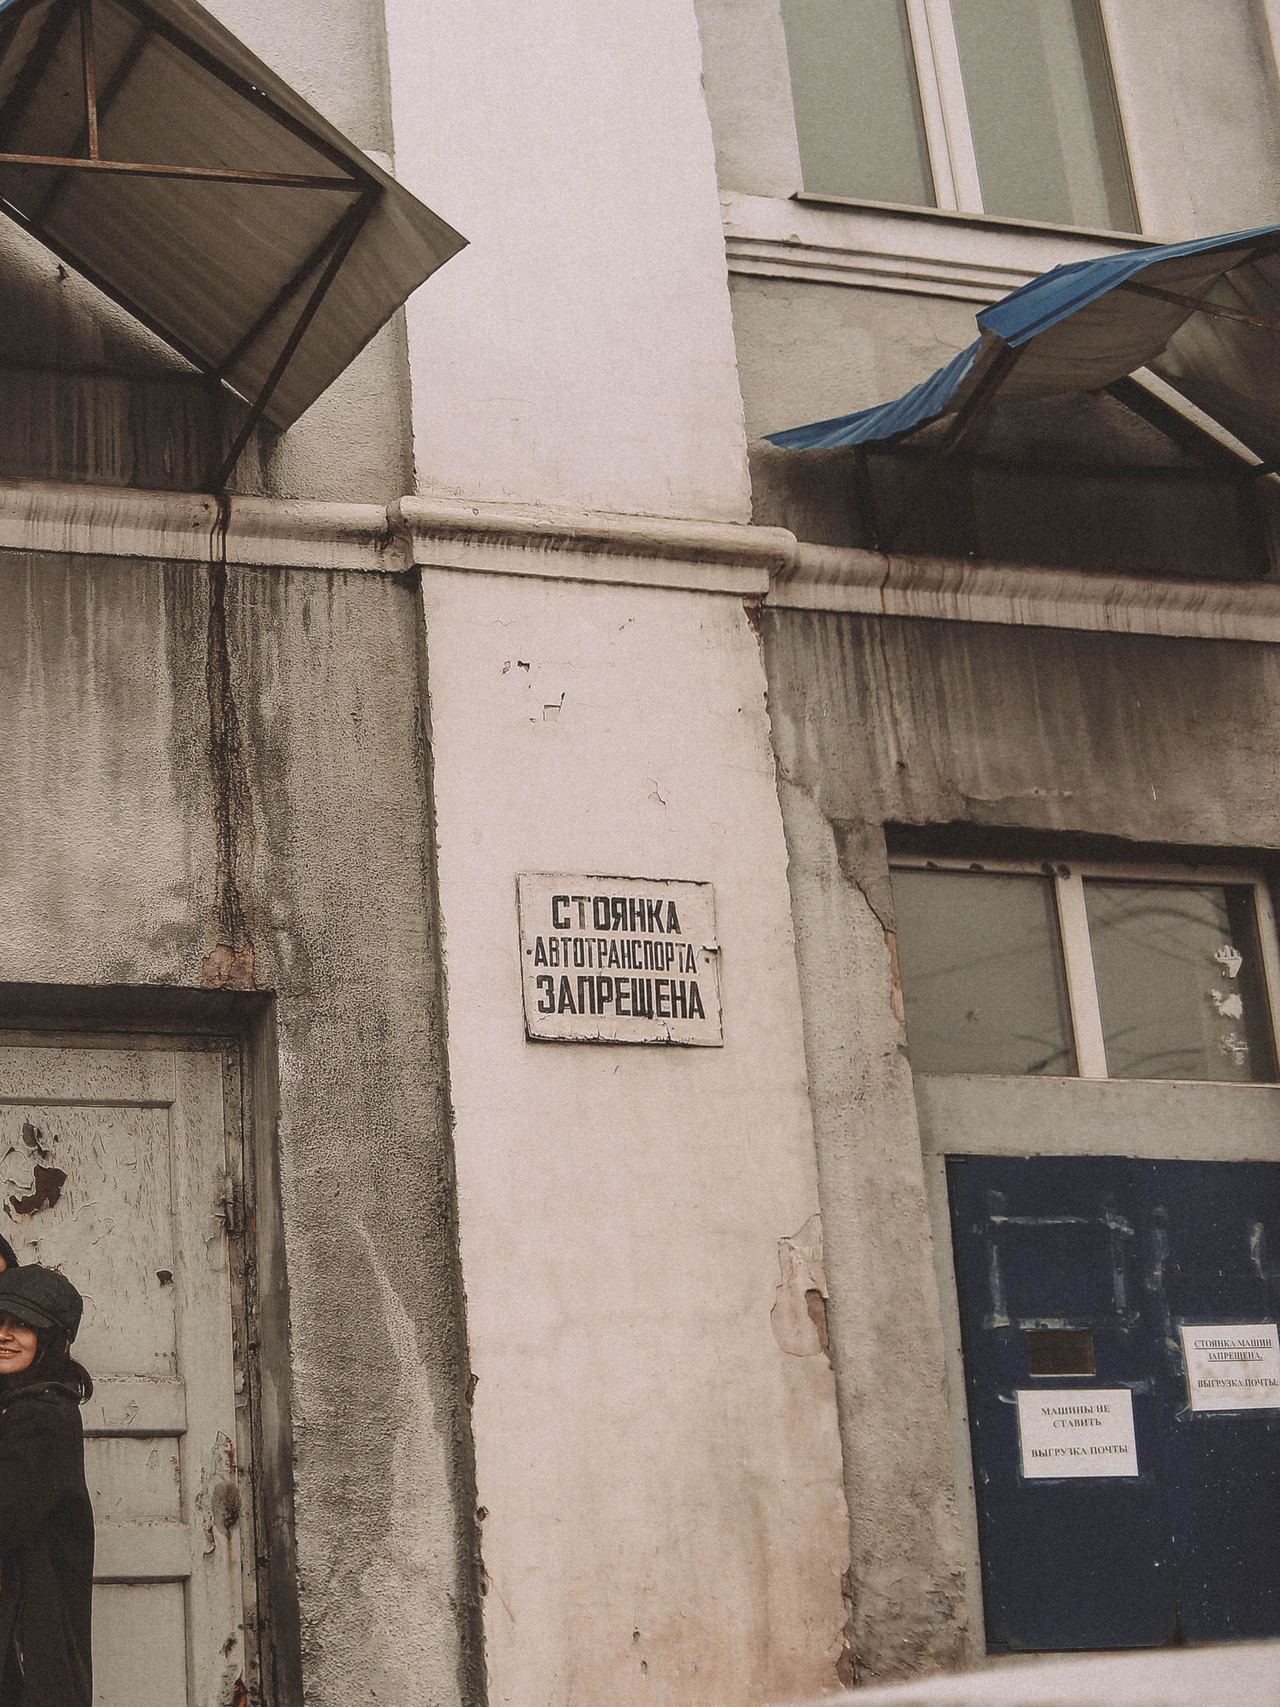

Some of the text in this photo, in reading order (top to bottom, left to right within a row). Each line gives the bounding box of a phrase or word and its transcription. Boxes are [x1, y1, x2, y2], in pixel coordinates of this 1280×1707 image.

[551, 895, 682, 934] СТОЯНКА
[534, 936, 698, 974] АВТОТРАНСПОРТА
[536, 974, 706, 1019] ЗАПРЕЩЕНА
[1194, 1339, 1272, 1348] СТОЯНКА МАШИН
[1197, 1380, 1243, 1388] ВЫГРУЗКА
[1041, 1404, 1111, 1416] МАШИНЫ НЕ
[1053, 1418, 1102, 1428] СТАВИТЬ
[1031, 1444, 1128, 1458] ВЫГРУЗКА ПОЧТЫ
